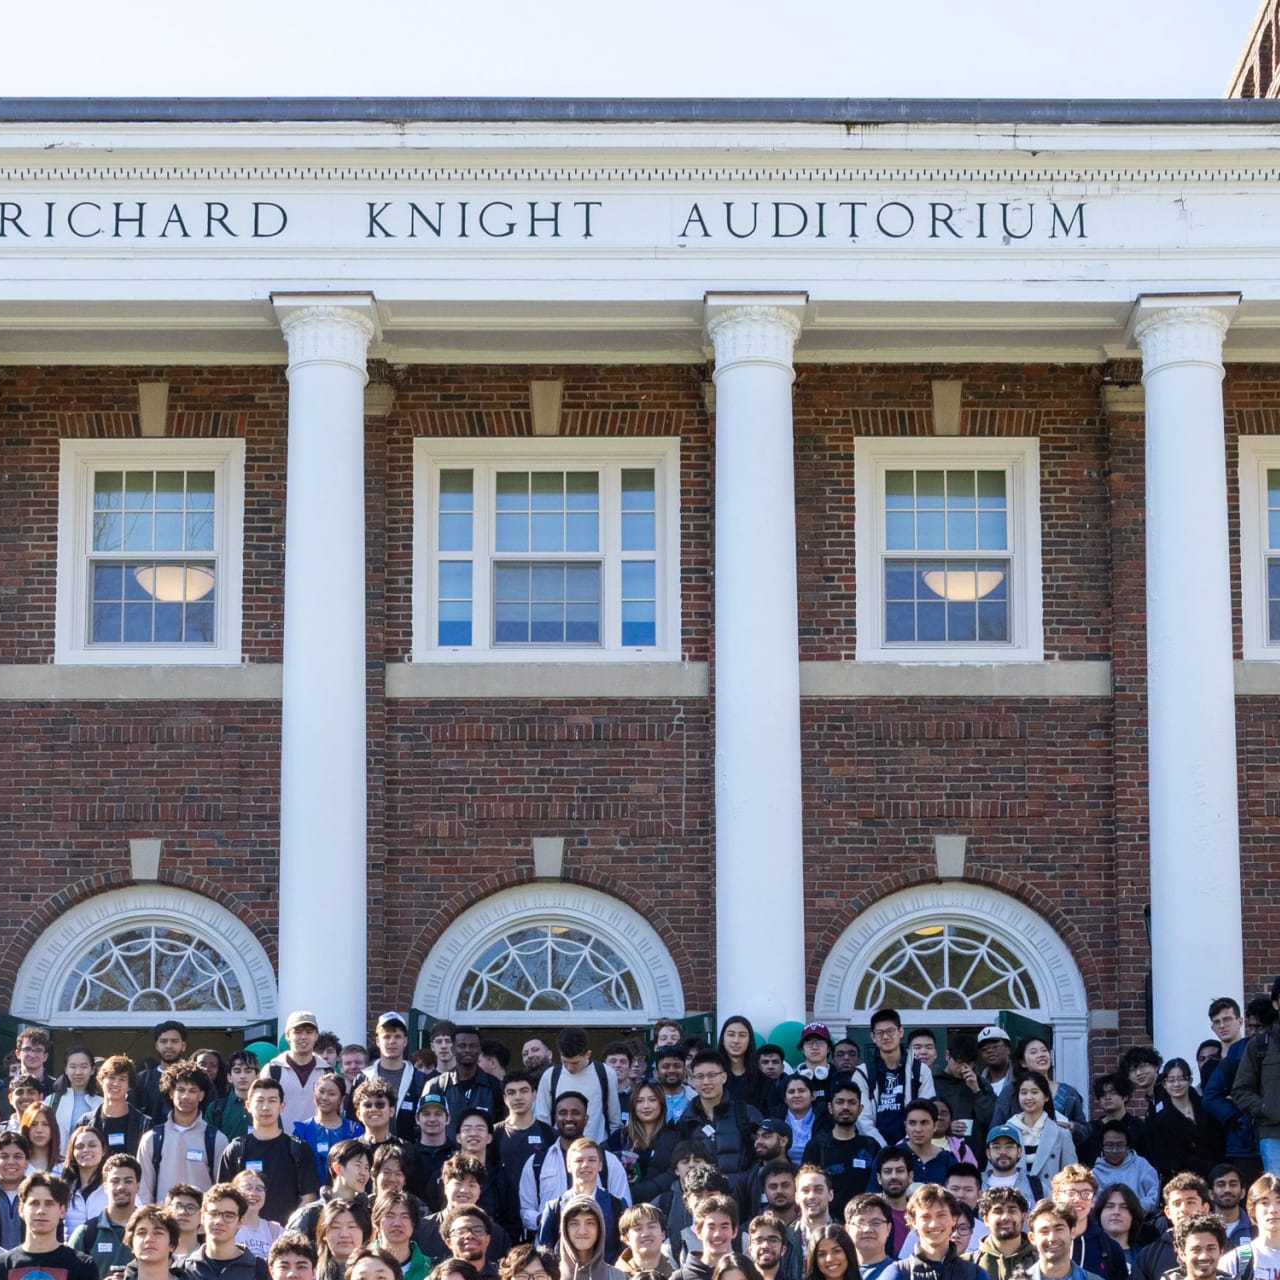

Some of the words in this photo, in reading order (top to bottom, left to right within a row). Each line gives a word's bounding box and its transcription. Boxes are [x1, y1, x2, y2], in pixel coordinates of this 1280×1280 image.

[0, 202, 288, 238] RICHARD
[367, 202, 602, 238] KNIGHT
[679, 202, 1087, 239] AUDITORIUM
